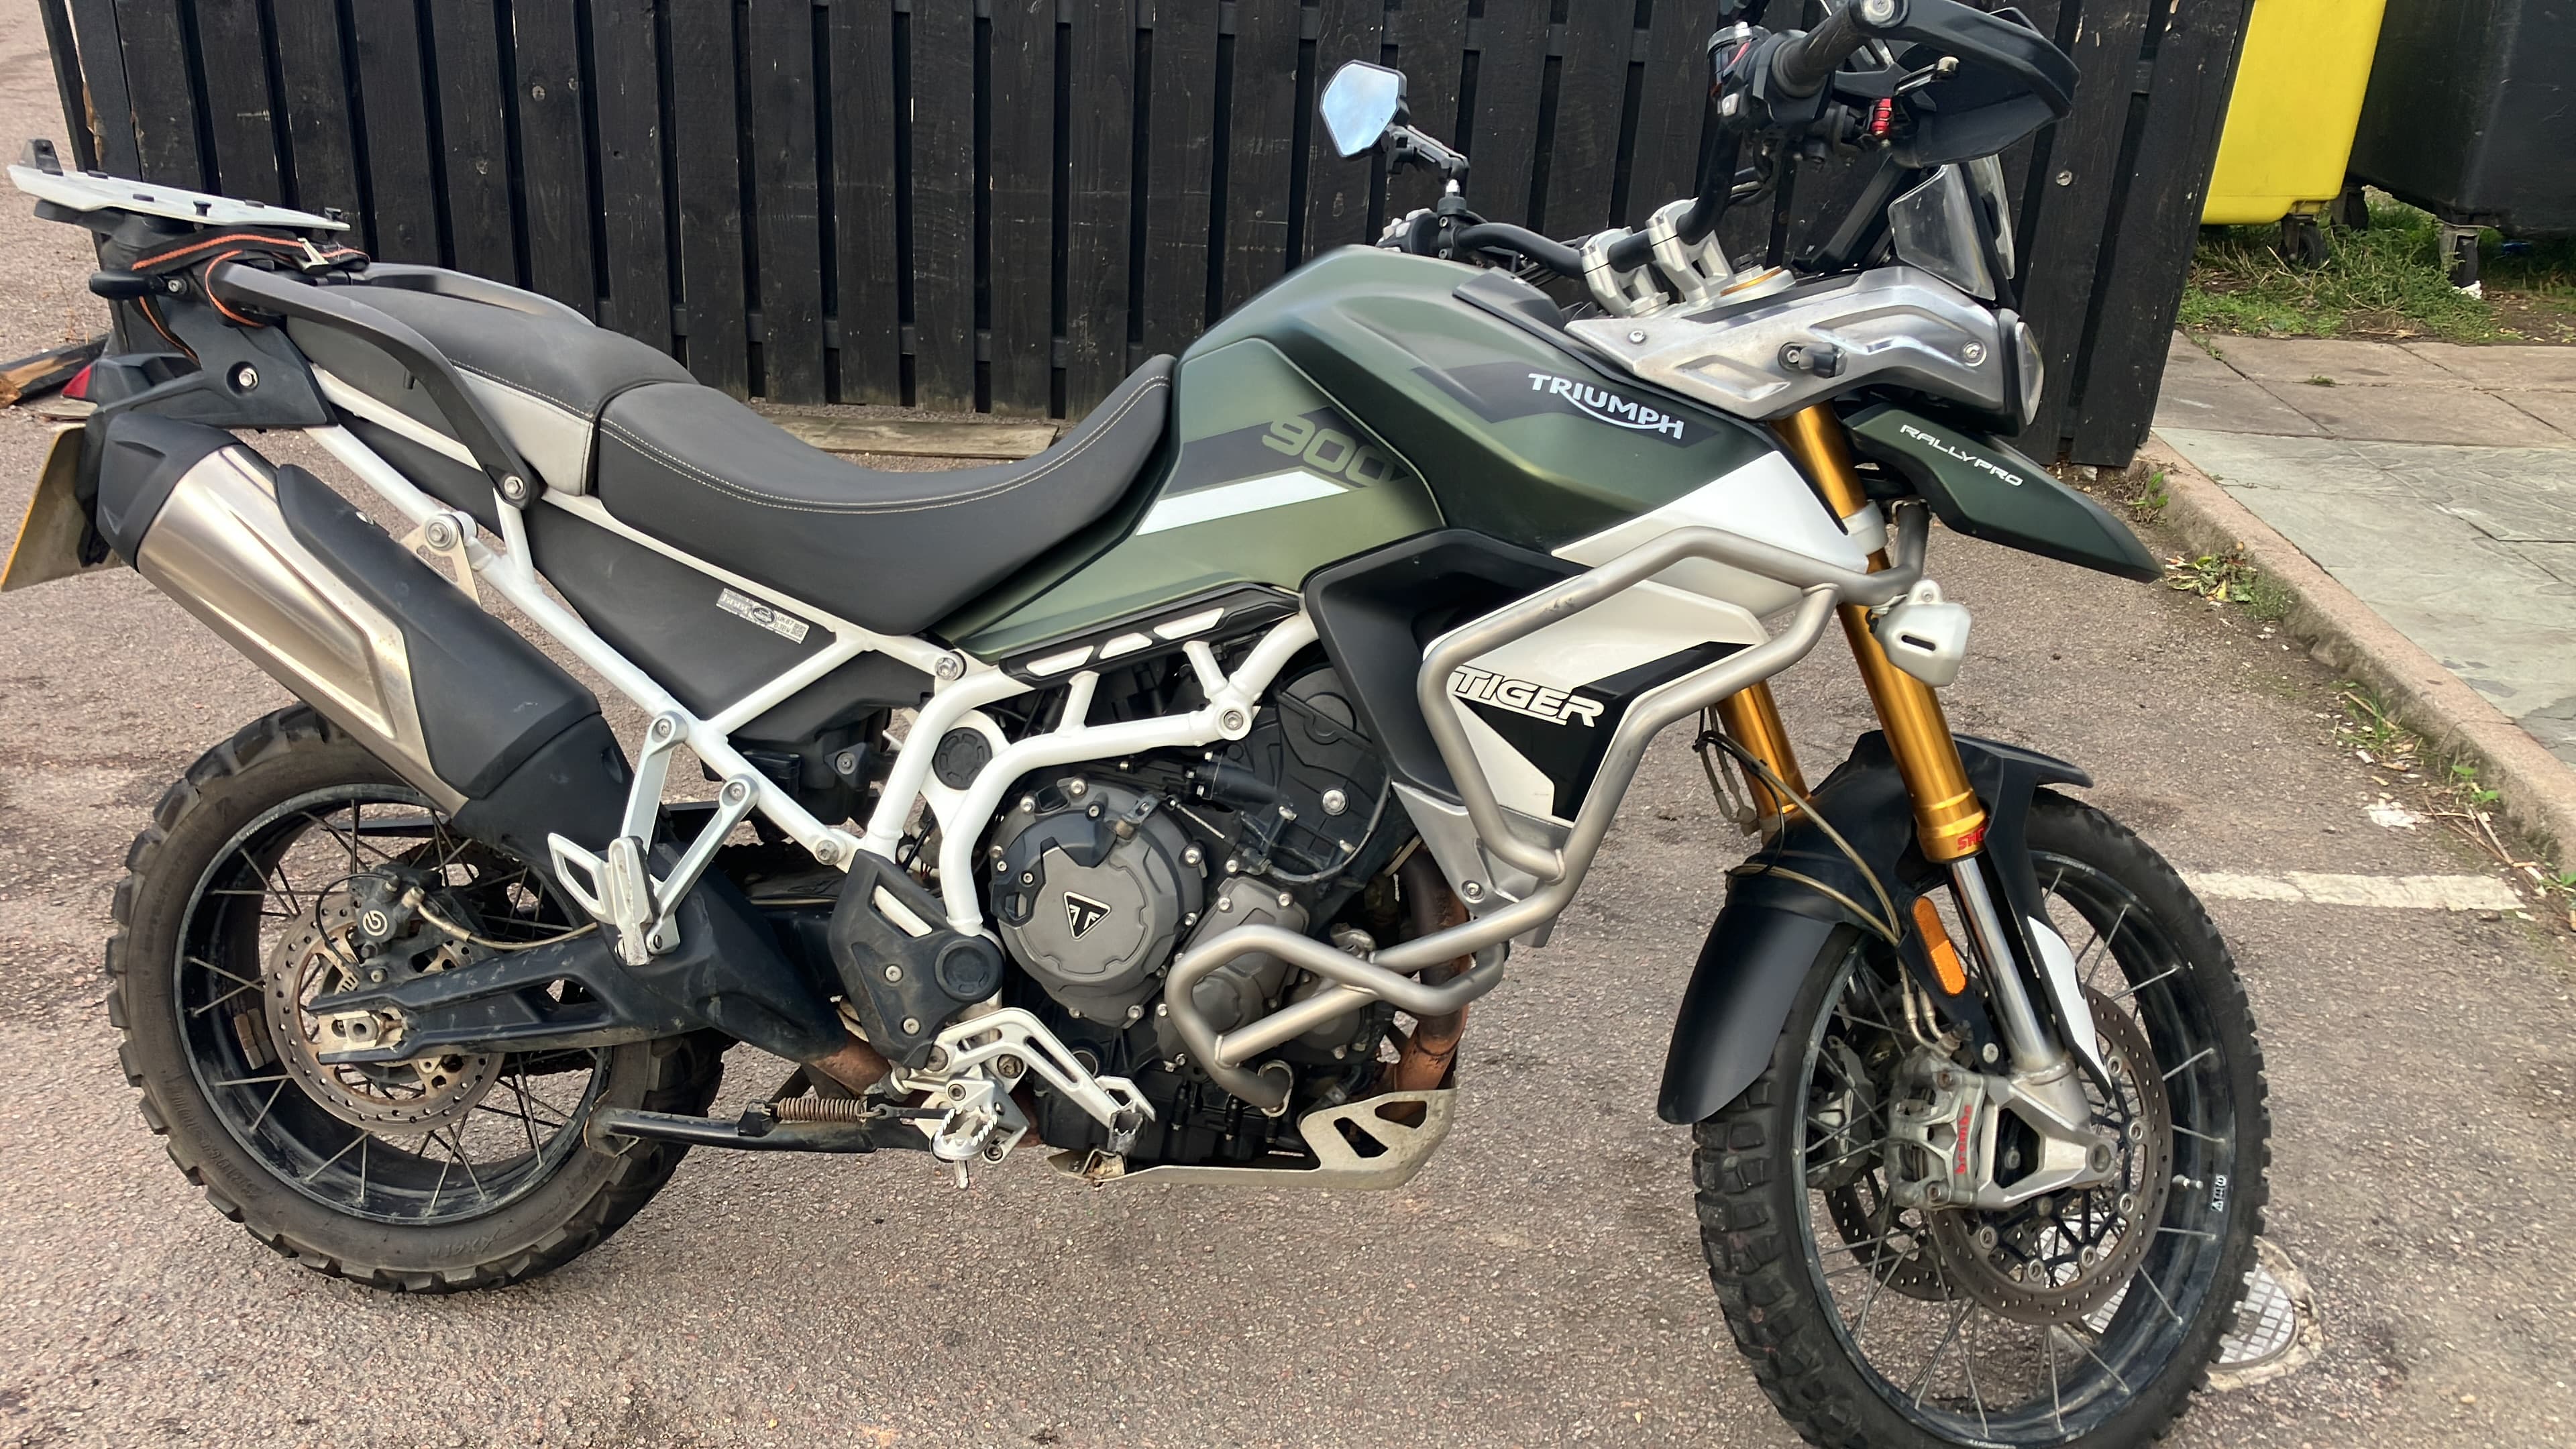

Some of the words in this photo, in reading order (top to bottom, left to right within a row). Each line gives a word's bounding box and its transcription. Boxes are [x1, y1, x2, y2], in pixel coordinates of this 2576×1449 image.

[1528, 373, 1685, 439] TRIUMPH
[1261, 415, 1396, 488] 900
[1454, 664, 1605, 728] TIGER
[1954, 1105, 1972, 1175] brembo
